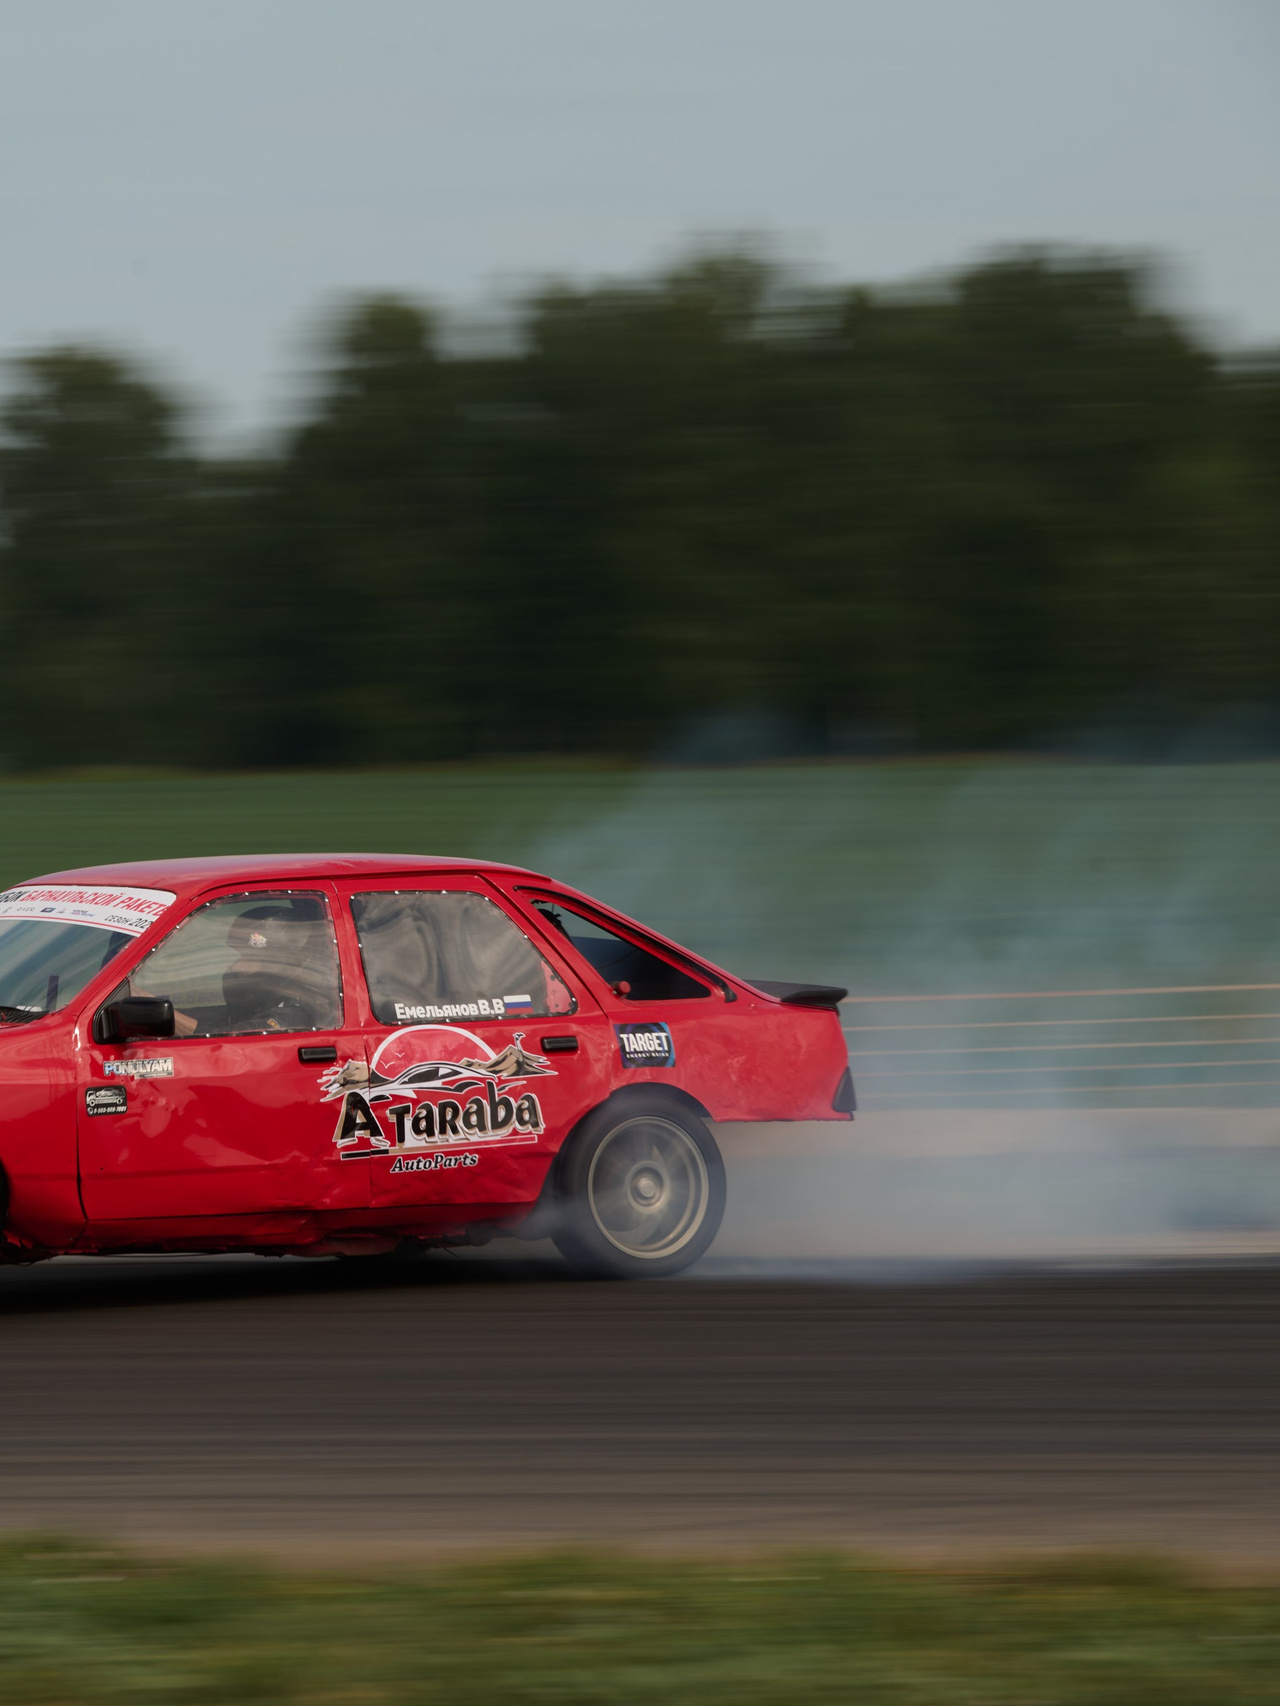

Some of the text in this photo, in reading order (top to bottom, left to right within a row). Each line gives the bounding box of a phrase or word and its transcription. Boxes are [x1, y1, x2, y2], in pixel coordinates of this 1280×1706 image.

[20, 890, 126, 907] БАРНАУЛЬСКОЙ
[104, 914, 154, 930] СЕЗОН 202
[394, 1002, 480, 1020] Емельянов
[619, 1032, 669, 1052] TARGET
[391, 1152, 478, 1173] AutoParts
